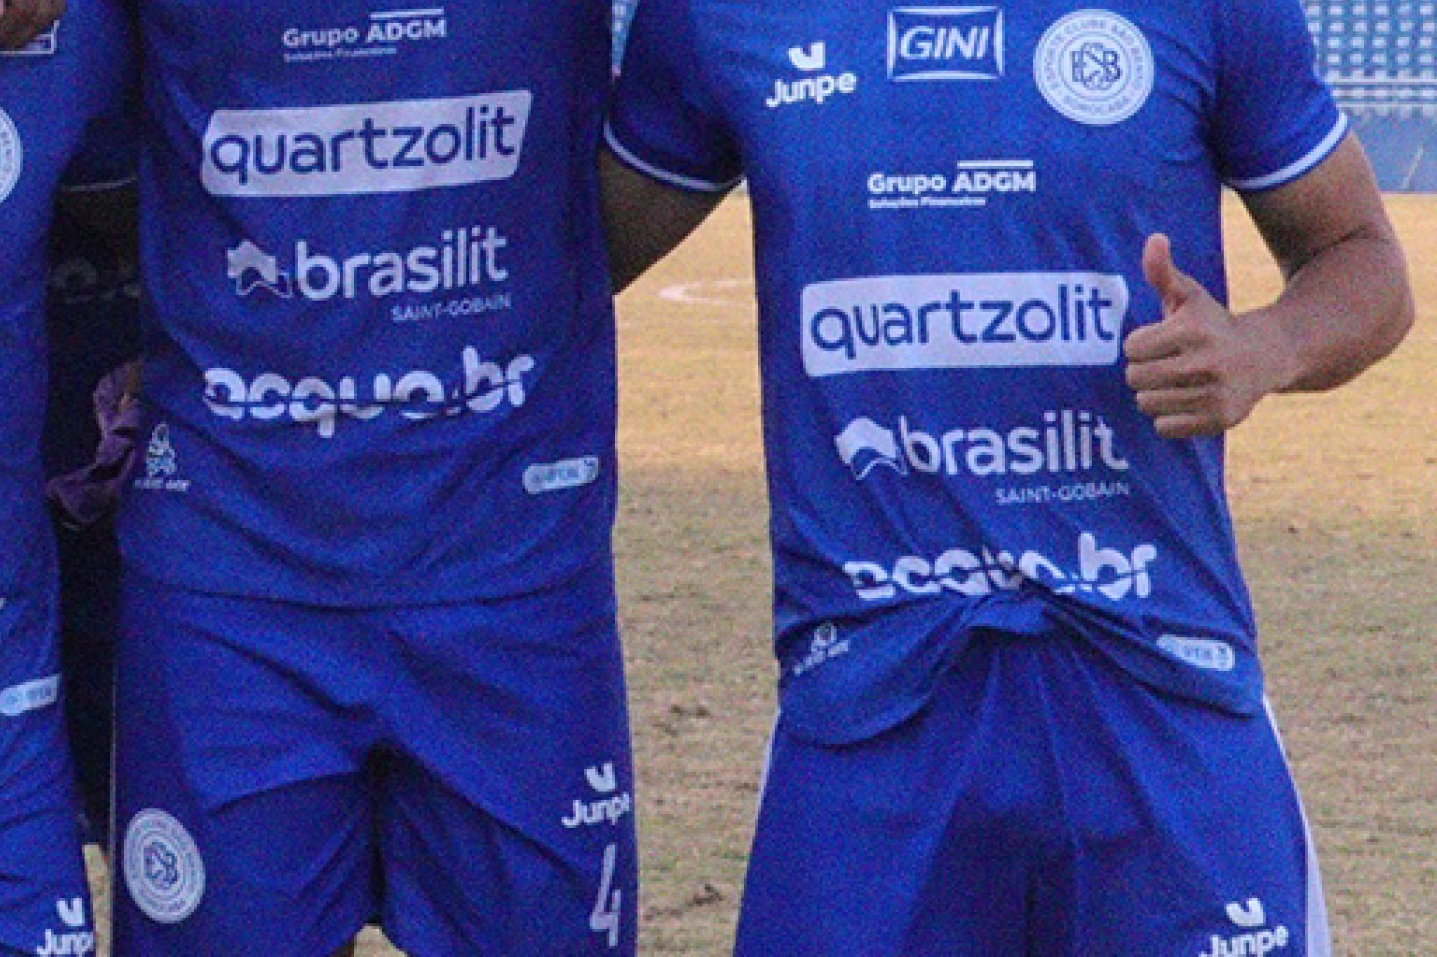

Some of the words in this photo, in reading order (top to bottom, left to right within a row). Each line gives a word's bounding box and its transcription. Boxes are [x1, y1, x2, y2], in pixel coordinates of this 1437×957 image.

[282, 27, 360, 49] Grupo
[365, 18, 446, 43] ADGM
[899, 25, 990, 60] GINI
[766, 68, 857, 108] Junpe
[209, 104, 516, 186] quartzolit
[867, 172, 947, 196] Grupo
[952, 170, 1036, 193] ADGM
[297, 226, 509, 301] brasilit
[810, 284, 1114, 360] quartzolit
[900, 409, 1129, 475] brasilit
[995, 481, 1130, 506] SAINT-GOBAIN
[590, 843, 622, 948] 4
